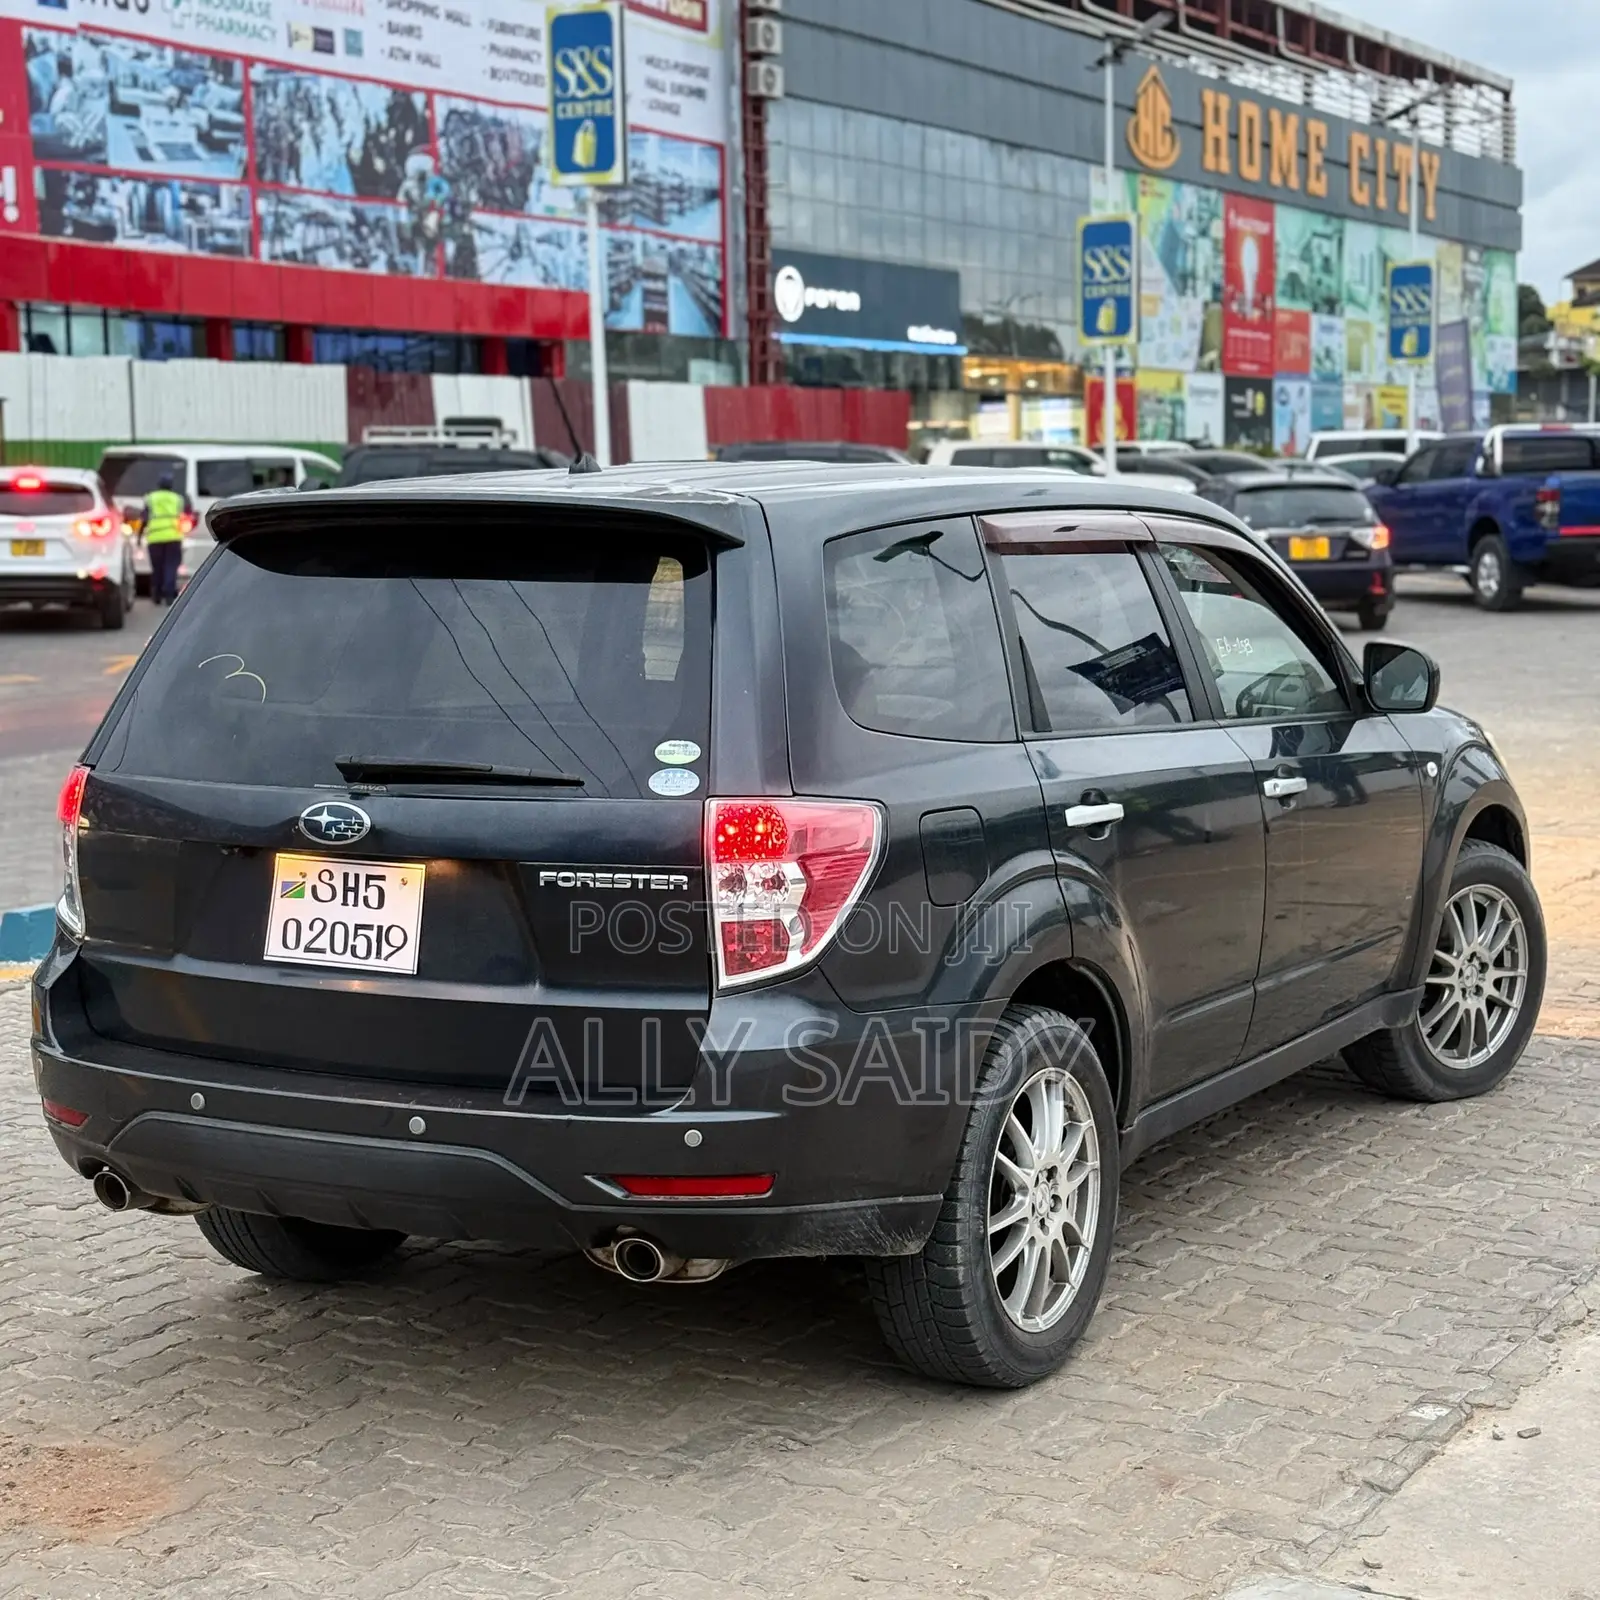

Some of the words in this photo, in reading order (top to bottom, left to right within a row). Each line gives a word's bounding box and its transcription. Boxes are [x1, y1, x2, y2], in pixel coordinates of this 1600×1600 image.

[194, 12, 278, 42] PHARMACY
[489, 42, 543, 65] PHARMACY
[1202, 87, 1329, 198] HOME
[1349, 131, 1441, 222] CITY
[311, 868, 387, 911] SH5
[538, 870, 689, 891] FORESTER
[281, 917, 409, 962] 020519
